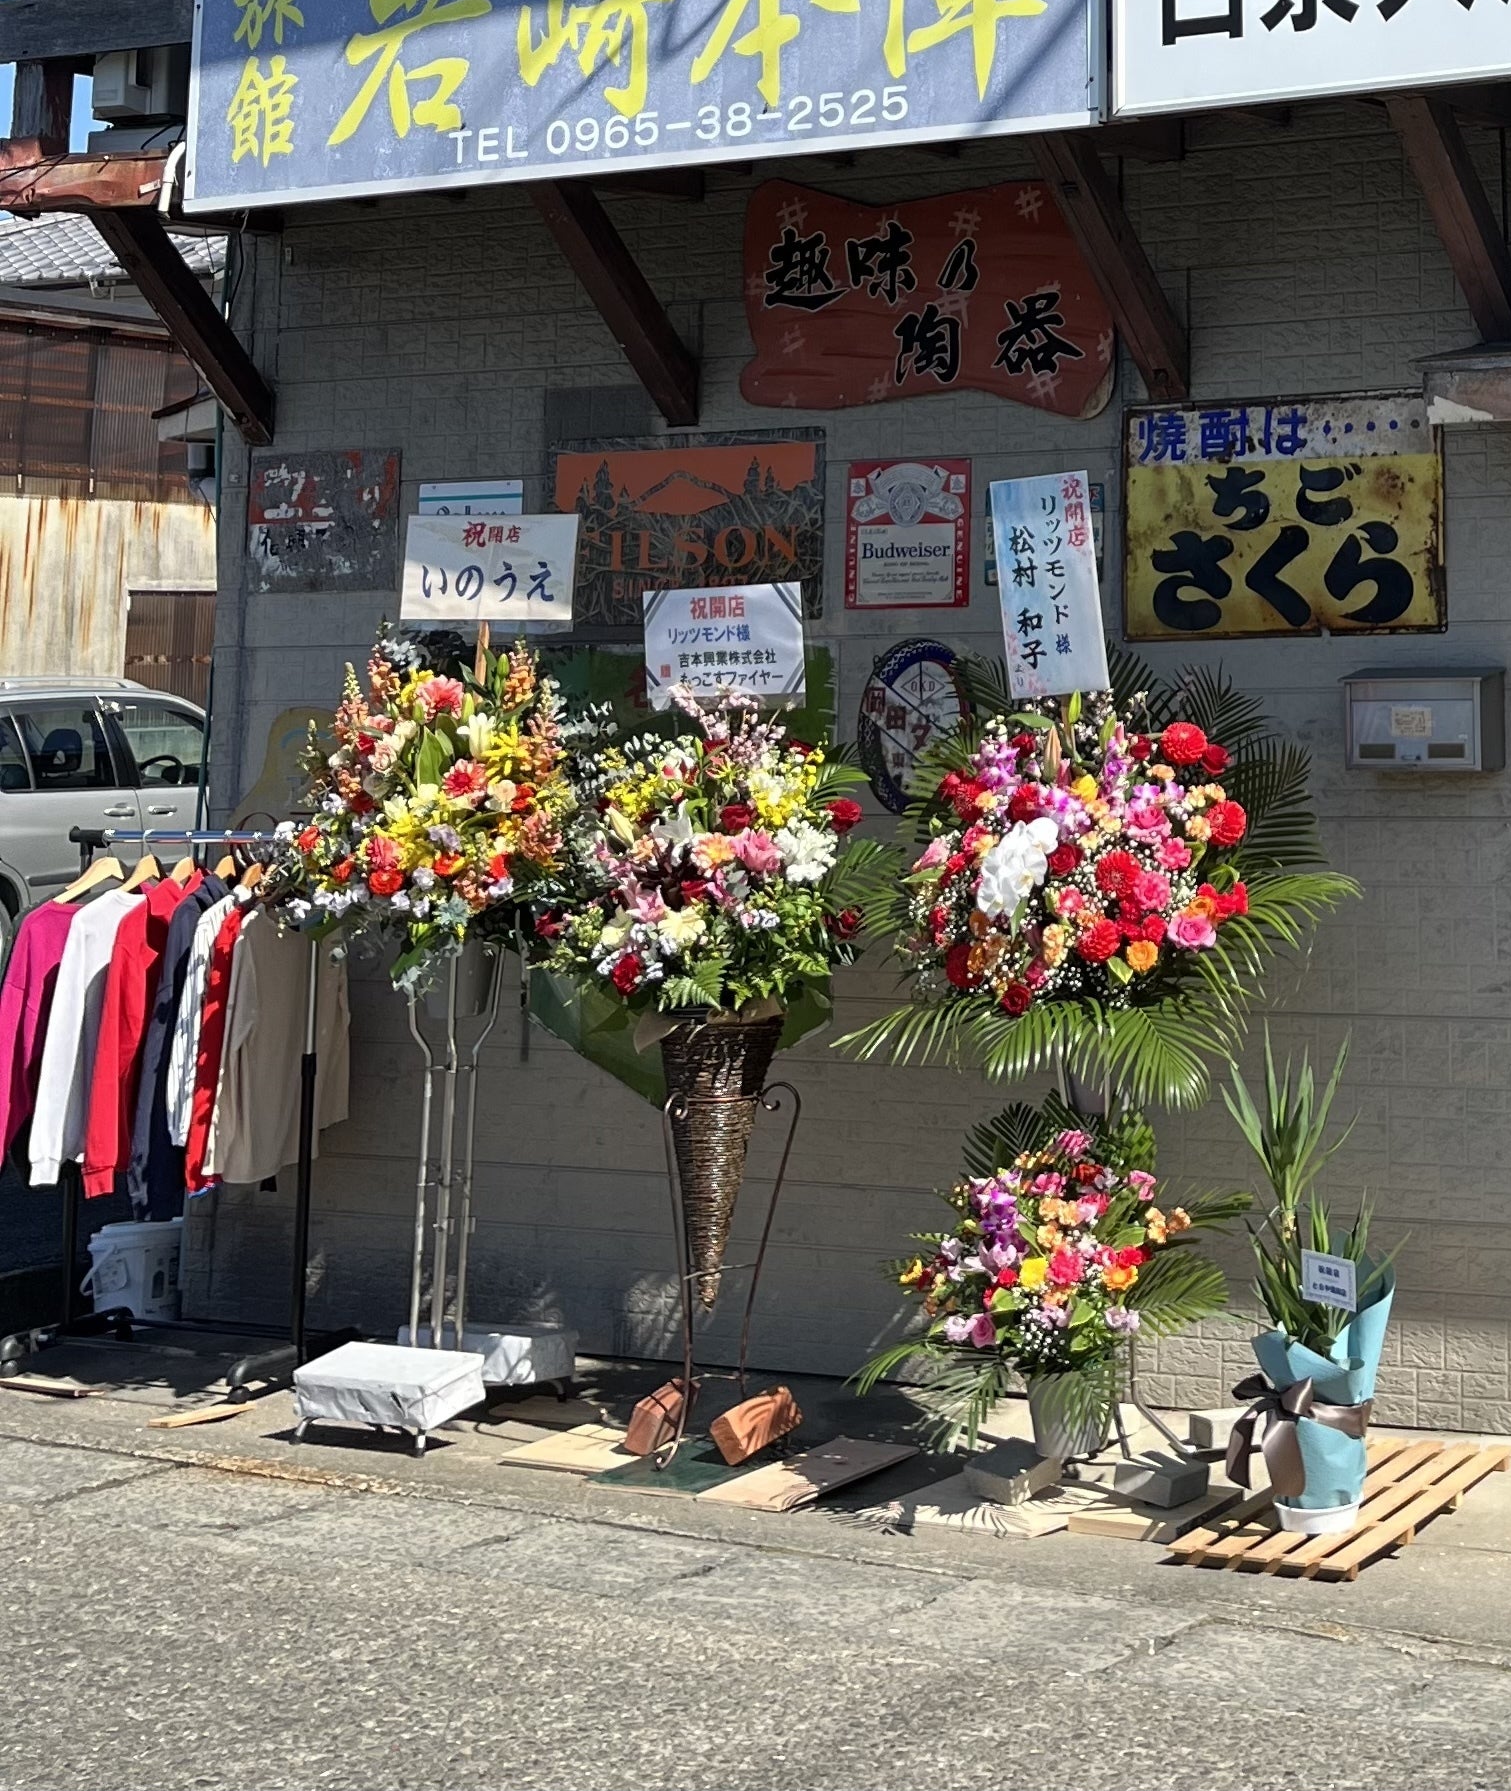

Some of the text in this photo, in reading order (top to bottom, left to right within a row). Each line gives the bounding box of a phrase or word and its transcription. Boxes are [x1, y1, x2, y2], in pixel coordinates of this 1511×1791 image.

[449, 84, 910, 165] TEL 0965-38-2525
[893, 291, 1086, 386] 陶器
[1062, 479, 1088, 548] 祝開店
[462, 520, 523, 548] 祝開店
[862, 541, 951, 559] Budweiser
[421, 560, 555, 603] いのうえ
[1152, 520, 1414, 631] さくら
[690, 594, 745, 620] 祝開店
[668, 623, 751, 645] リッツモンド様
[677, 648, 778, 669] 吉本興業株式会社
